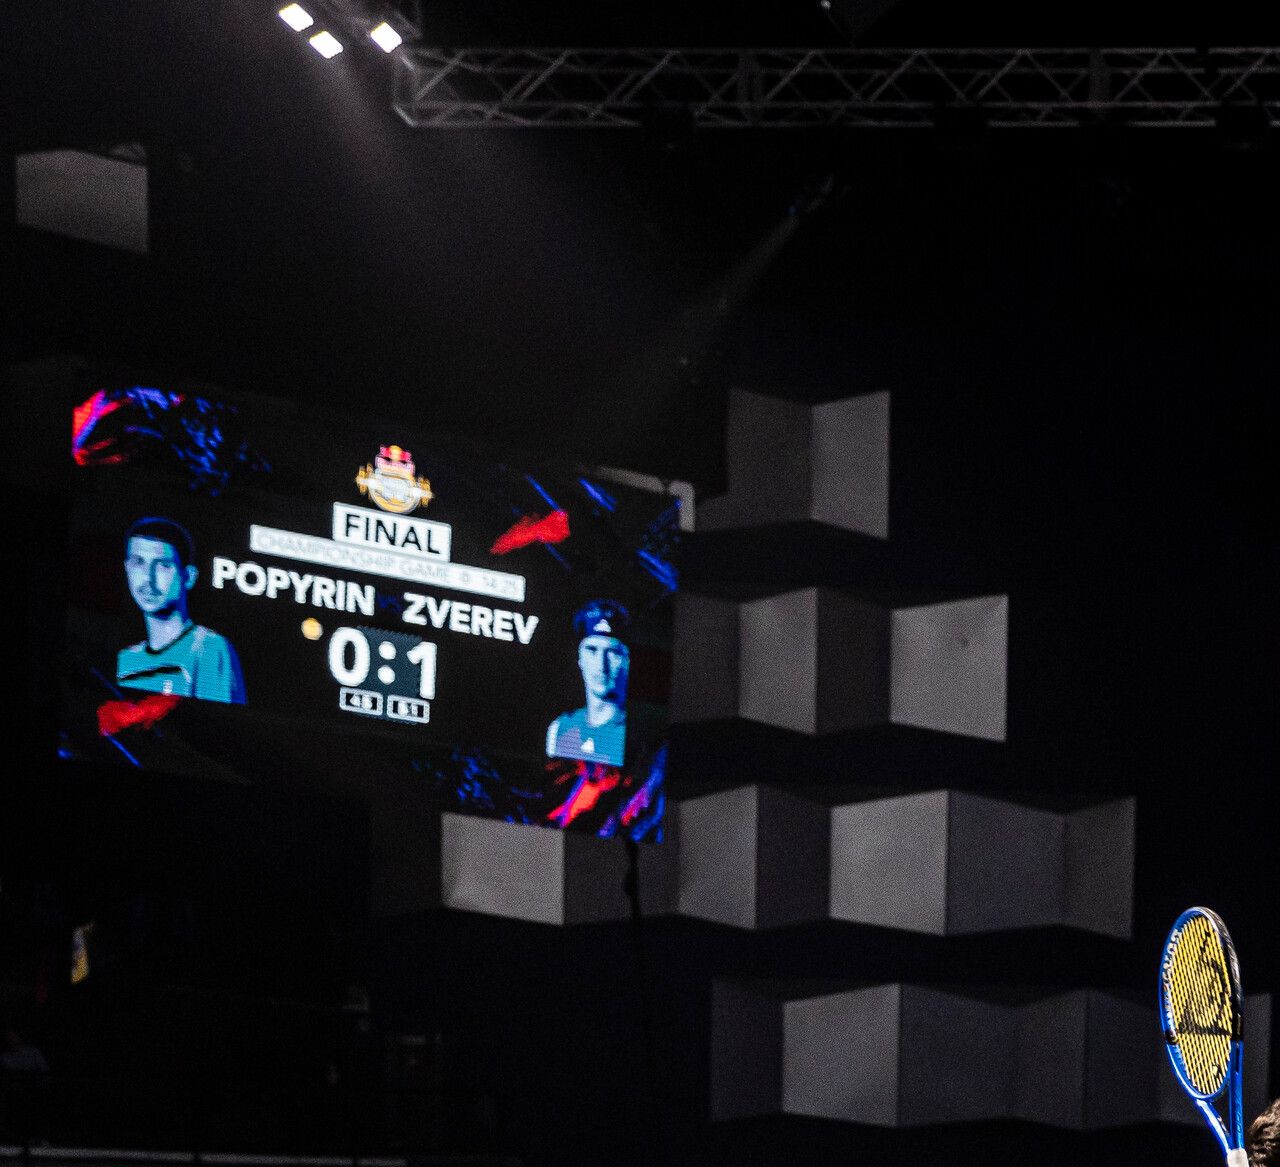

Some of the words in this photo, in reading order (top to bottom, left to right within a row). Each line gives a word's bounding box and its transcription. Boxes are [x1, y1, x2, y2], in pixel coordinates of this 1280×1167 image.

[344, 511, 441, 555] FINAL
[211, 555, 376, 617] POPYRIN
[401, 591, 540, 645] ZVEREV
[327, 626, 438, 700] 0:1
